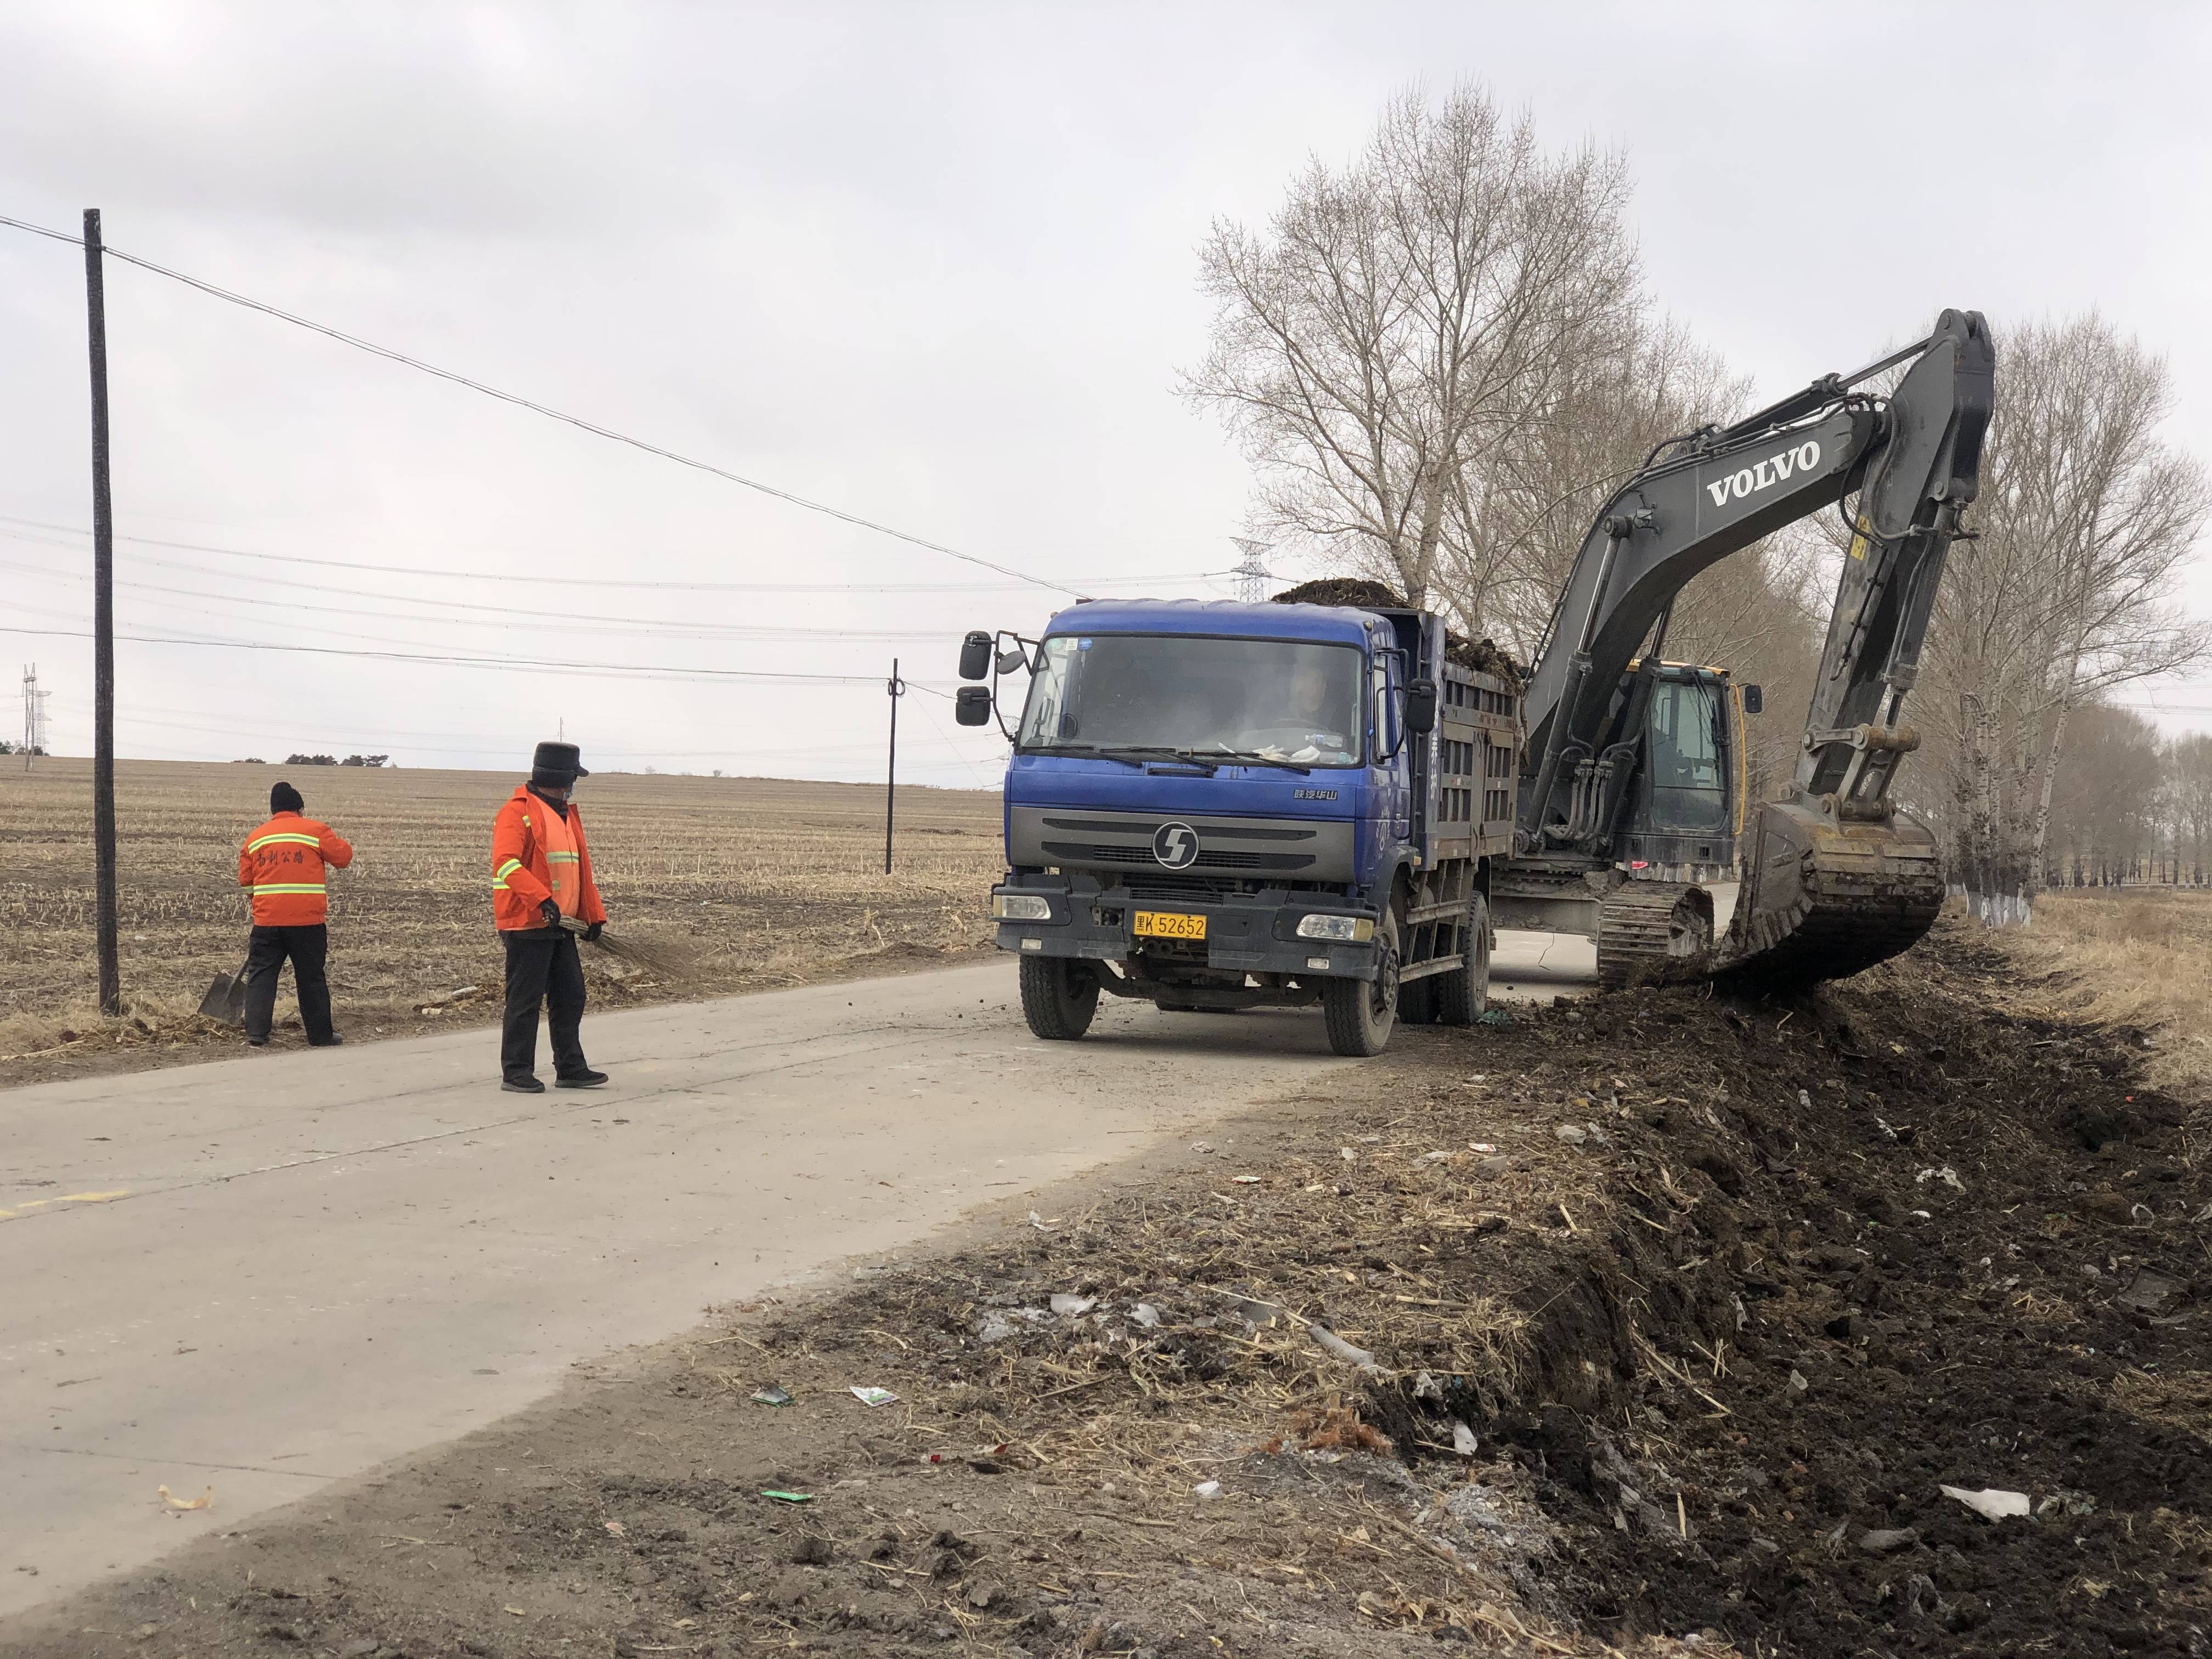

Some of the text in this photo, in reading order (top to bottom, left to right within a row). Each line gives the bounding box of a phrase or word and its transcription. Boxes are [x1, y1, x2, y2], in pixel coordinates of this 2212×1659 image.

[1707, 441, 1820, 507] VOLVO
[1294, 789, 1338, 800] 陕汽华山
